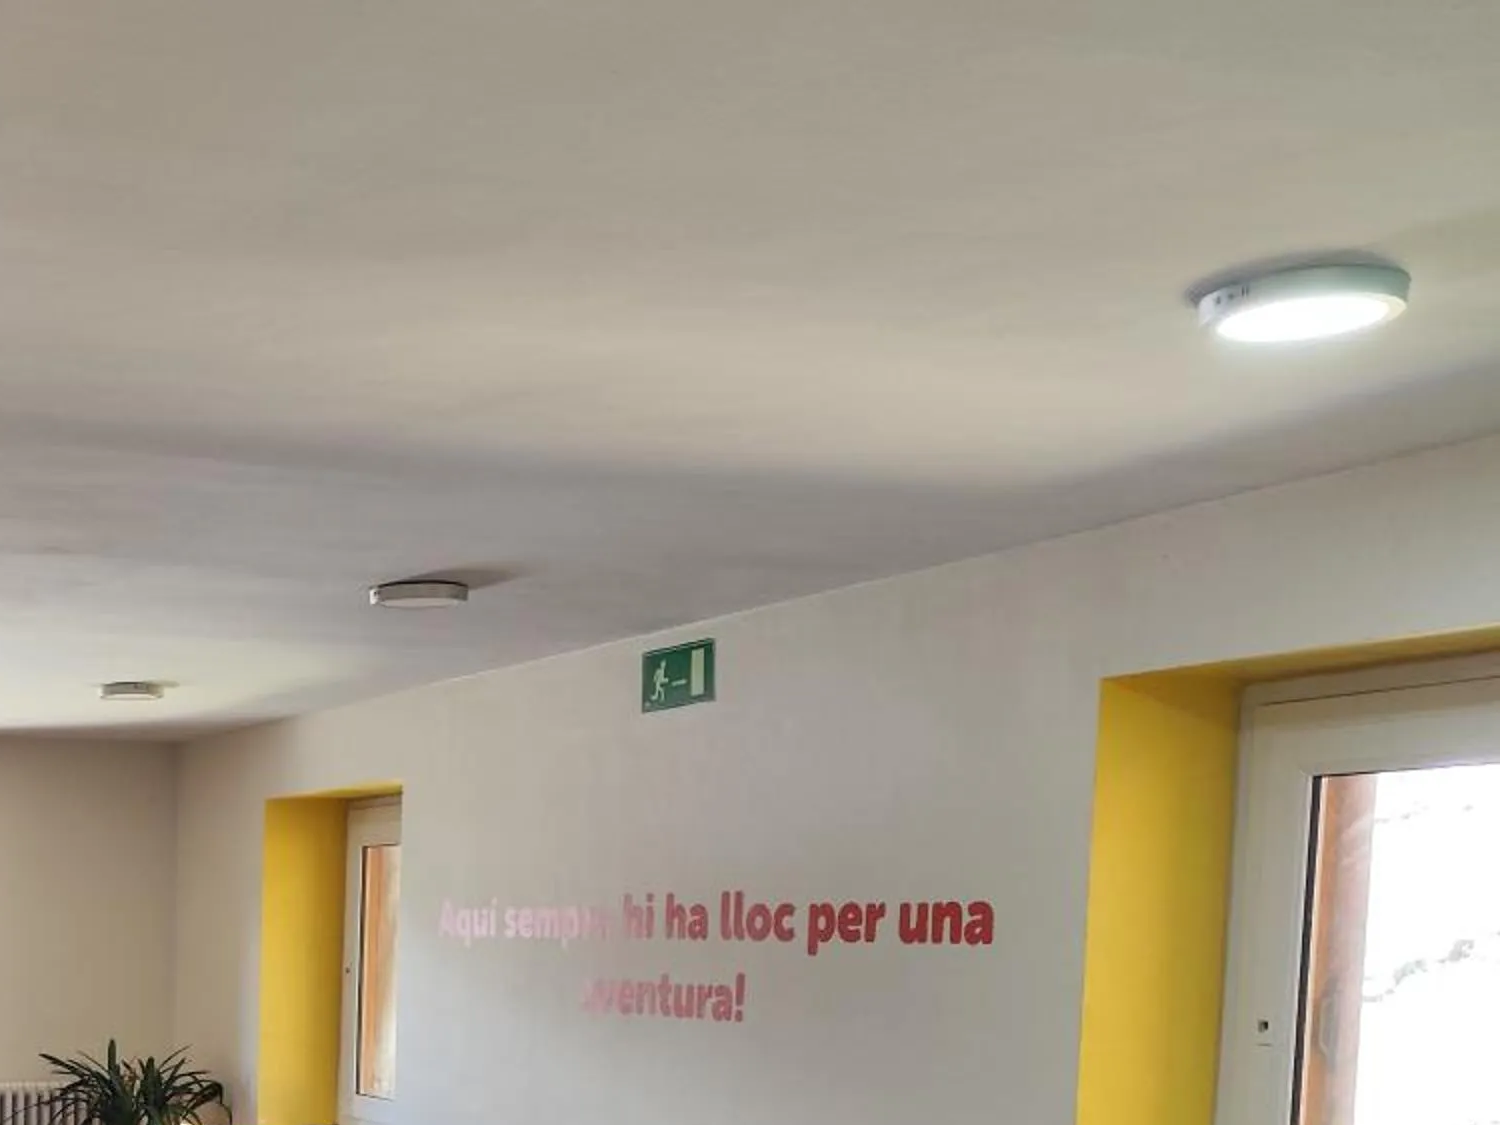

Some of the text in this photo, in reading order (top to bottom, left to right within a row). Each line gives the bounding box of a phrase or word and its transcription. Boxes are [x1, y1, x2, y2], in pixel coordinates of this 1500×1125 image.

[503, 906, 612, 949] semp
[622, 892, 655, 940] hi
[664, 893, 708, 941] ha
[719, 891, 796, 943] lloc
[807, 899, 887, 956] per
[899, 899, 994, 945] una
[580, 972, 746, 1023] ventura!
